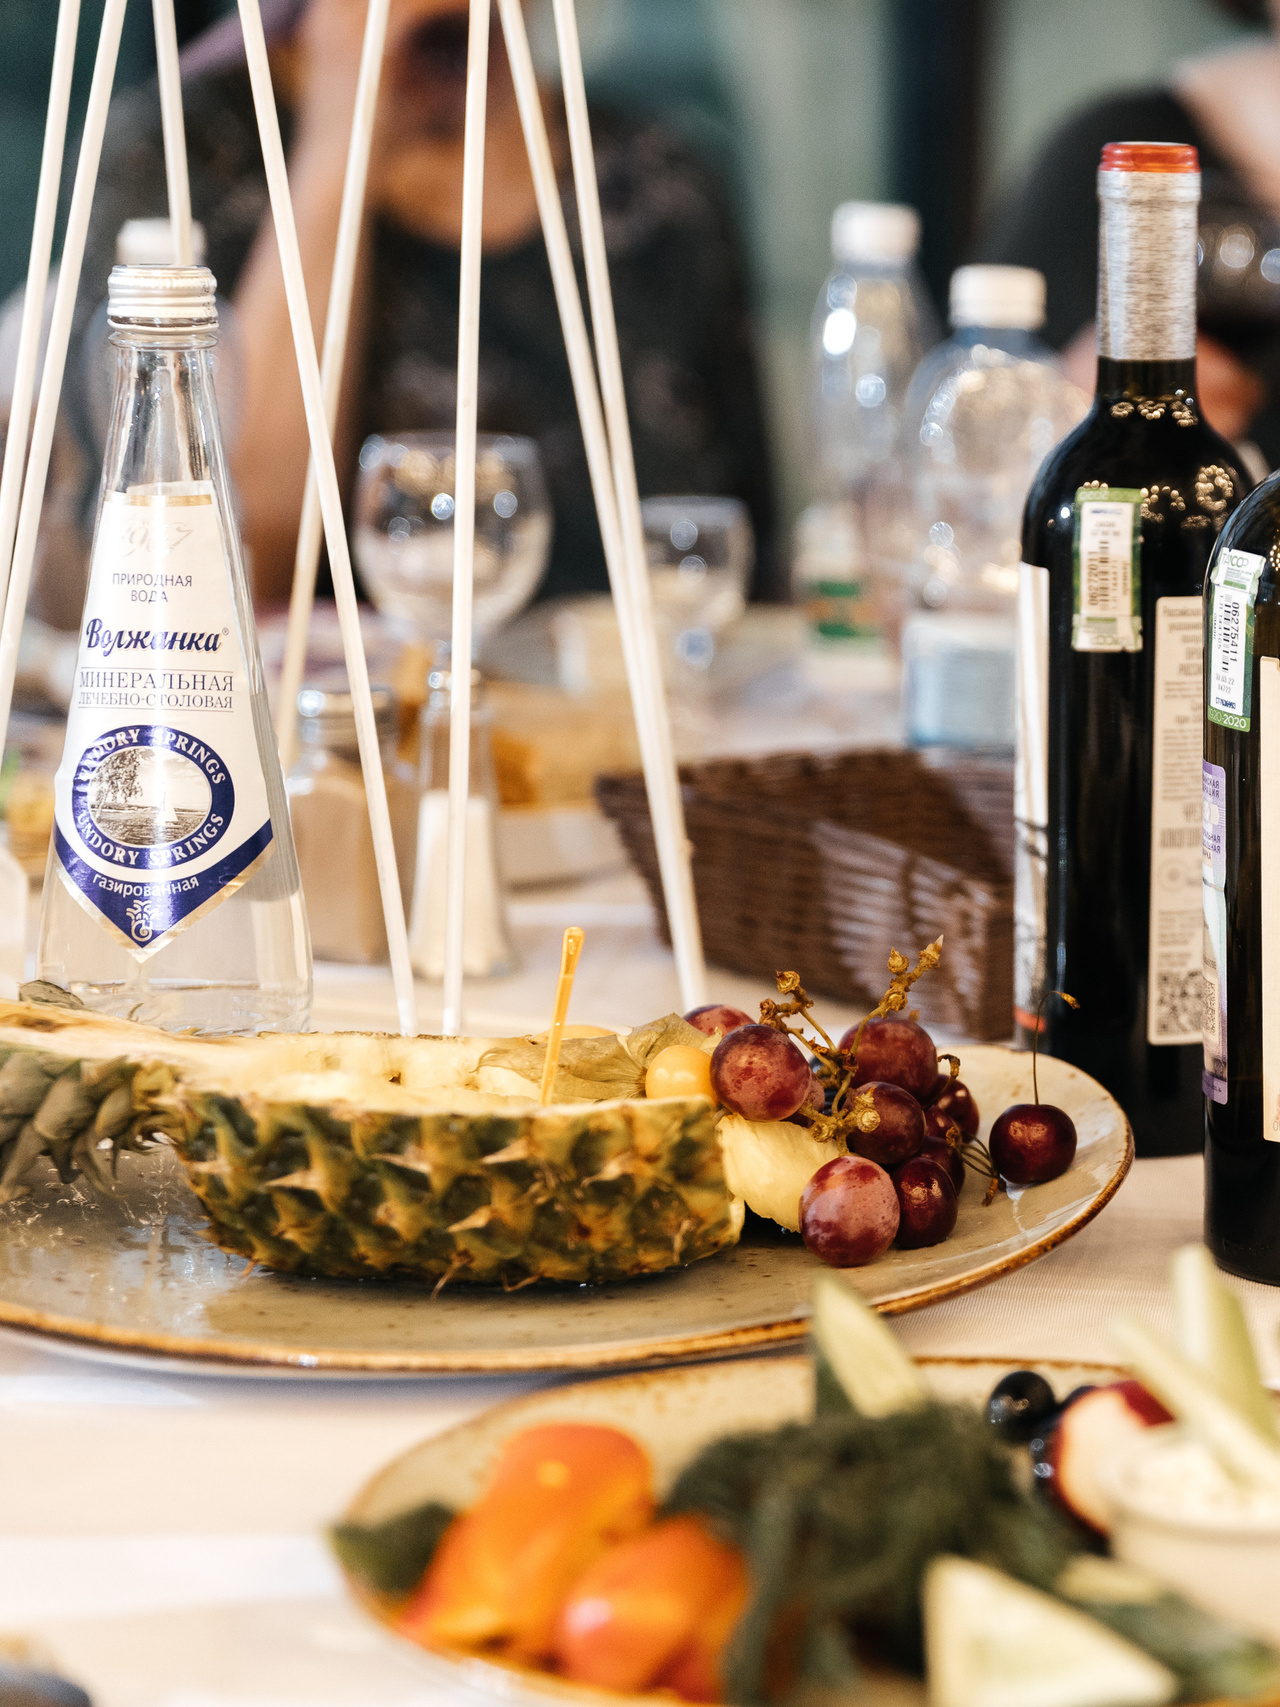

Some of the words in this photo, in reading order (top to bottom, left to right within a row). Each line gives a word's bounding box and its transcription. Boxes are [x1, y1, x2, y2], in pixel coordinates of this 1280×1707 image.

[112, 573, 193, 588] ПРИРОДНАЯ
[131, 590, 168, 604] ВОДА
[86, 618, 223, 657] Волжанка
[1229, 601, 1240, 662] 06275411
[79, 671, 234, 692] МИНЕРАЛЬНАЯ
[151, 728, 226, 784] SPRINGS
[77, 810, 140, 866] UNDORY
[149, 813, 224, 866] SPRINGS
[92, 872, 200, 898] газированная
